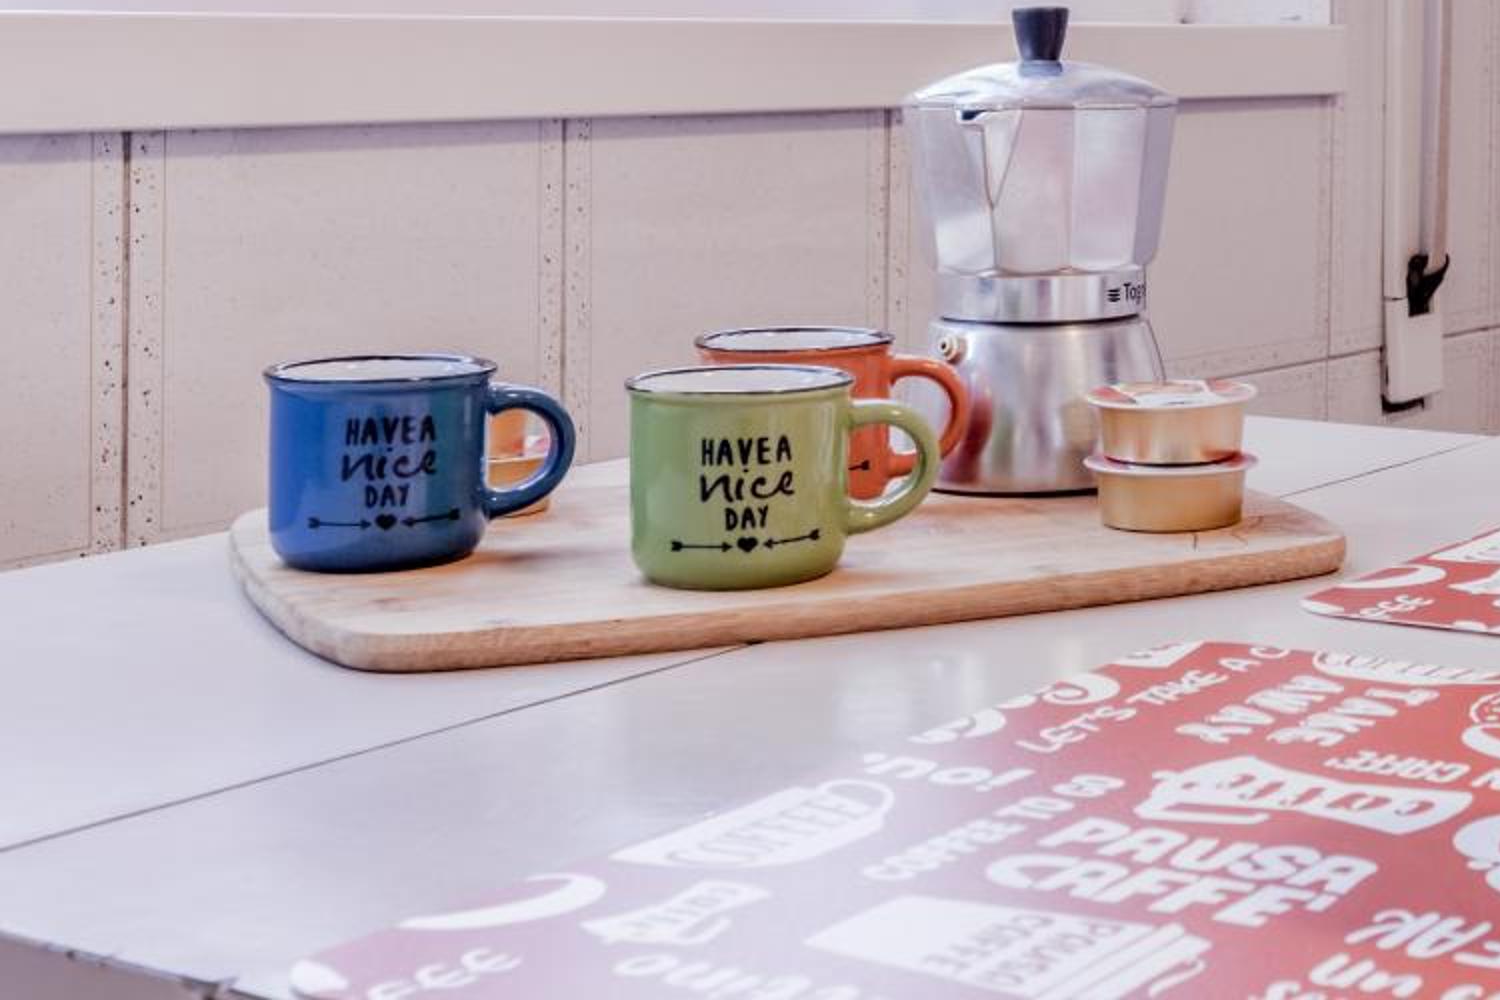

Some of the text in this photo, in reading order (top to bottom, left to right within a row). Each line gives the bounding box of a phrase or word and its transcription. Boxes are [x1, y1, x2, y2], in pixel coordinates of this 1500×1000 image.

[341, 446, 437, 482] nice
[365, 482, 411, 508] DAY
[700, 469, 795, 503] nice
[724, 504, 768, 531] DAY
[1036, 816, 1379, 894] PAUSA
[986, 853, 1339, 928] CAFFE'
